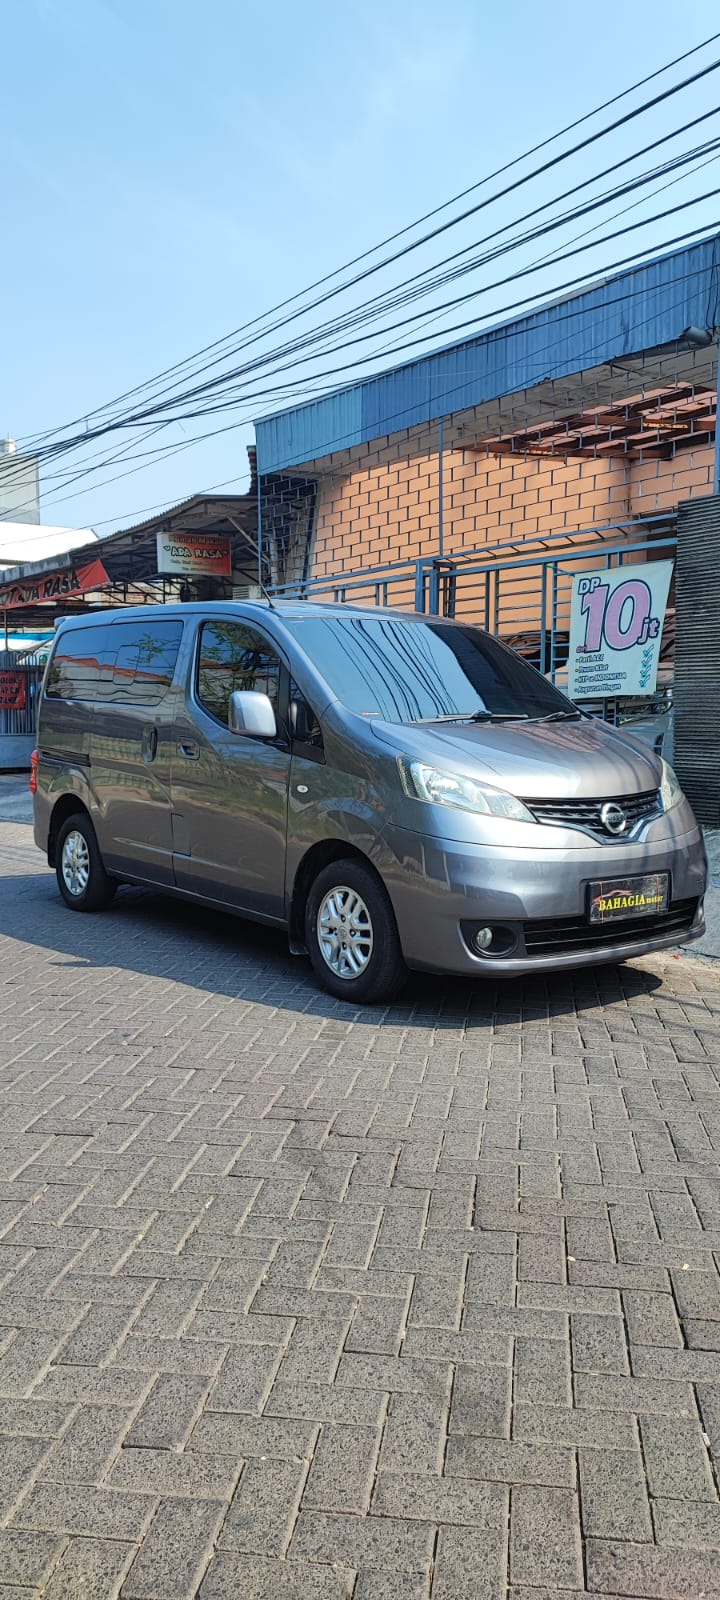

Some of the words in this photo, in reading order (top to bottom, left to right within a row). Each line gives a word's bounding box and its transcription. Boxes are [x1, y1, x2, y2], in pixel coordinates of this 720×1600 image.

[43, 567, 81, 599] RASA
[578, 577, 601, 595] DP
[594, 671, 627, 682] INDONESIA
[599, 895, 645, 911] BAHAGIA
[646, 896, 663, 904] motor
